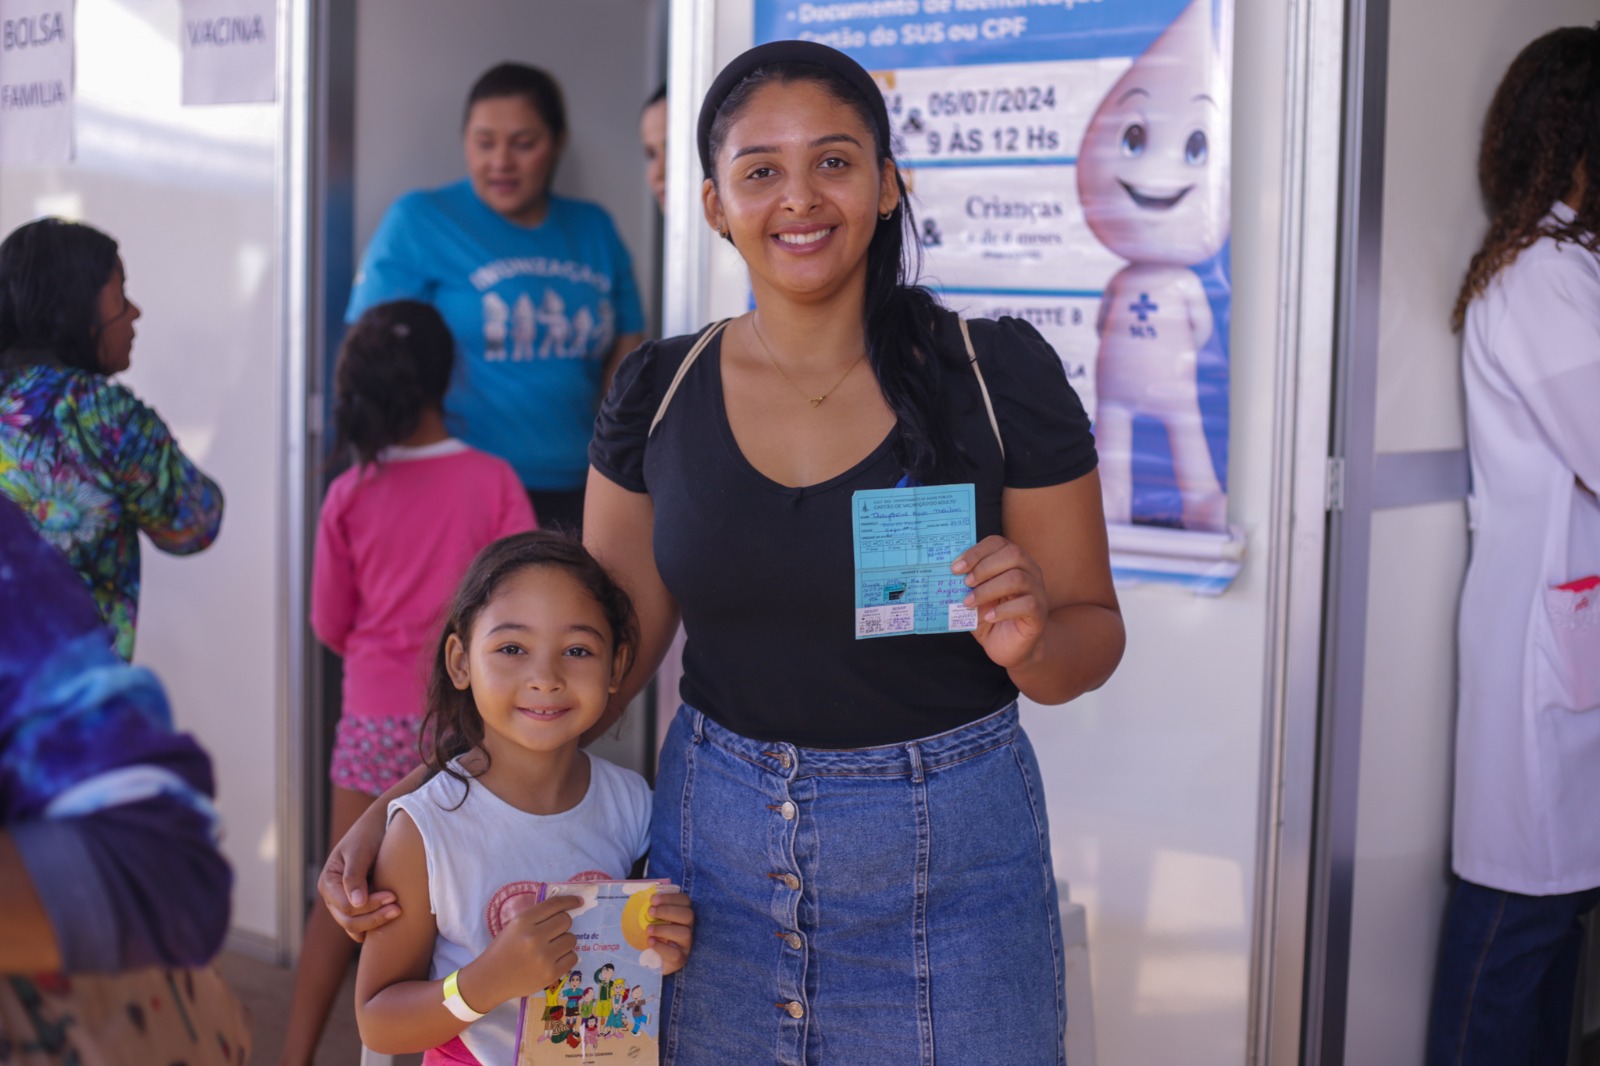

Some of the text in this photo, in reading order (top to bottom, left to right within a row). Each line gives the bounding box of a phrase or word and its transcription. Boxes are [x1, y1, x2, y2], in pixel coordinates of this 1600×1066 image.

[3, 11, 65, 50] BOLSA
[186, 14, 265, 48] VACINA
[901, 21, 945, 45] SUS
[947, 23, 978, 42] ou
[981, 16, 1028, 40] CPF
[950, 123, 983, 152] ÀS
[993, 127, 1020, 151] 12
[1027, 126, 1060, 150] Hs
[965, 194, 1063, 224] Crianças
[921, 218, 942, 248] &
[592, 943, 620, 952] Criança
